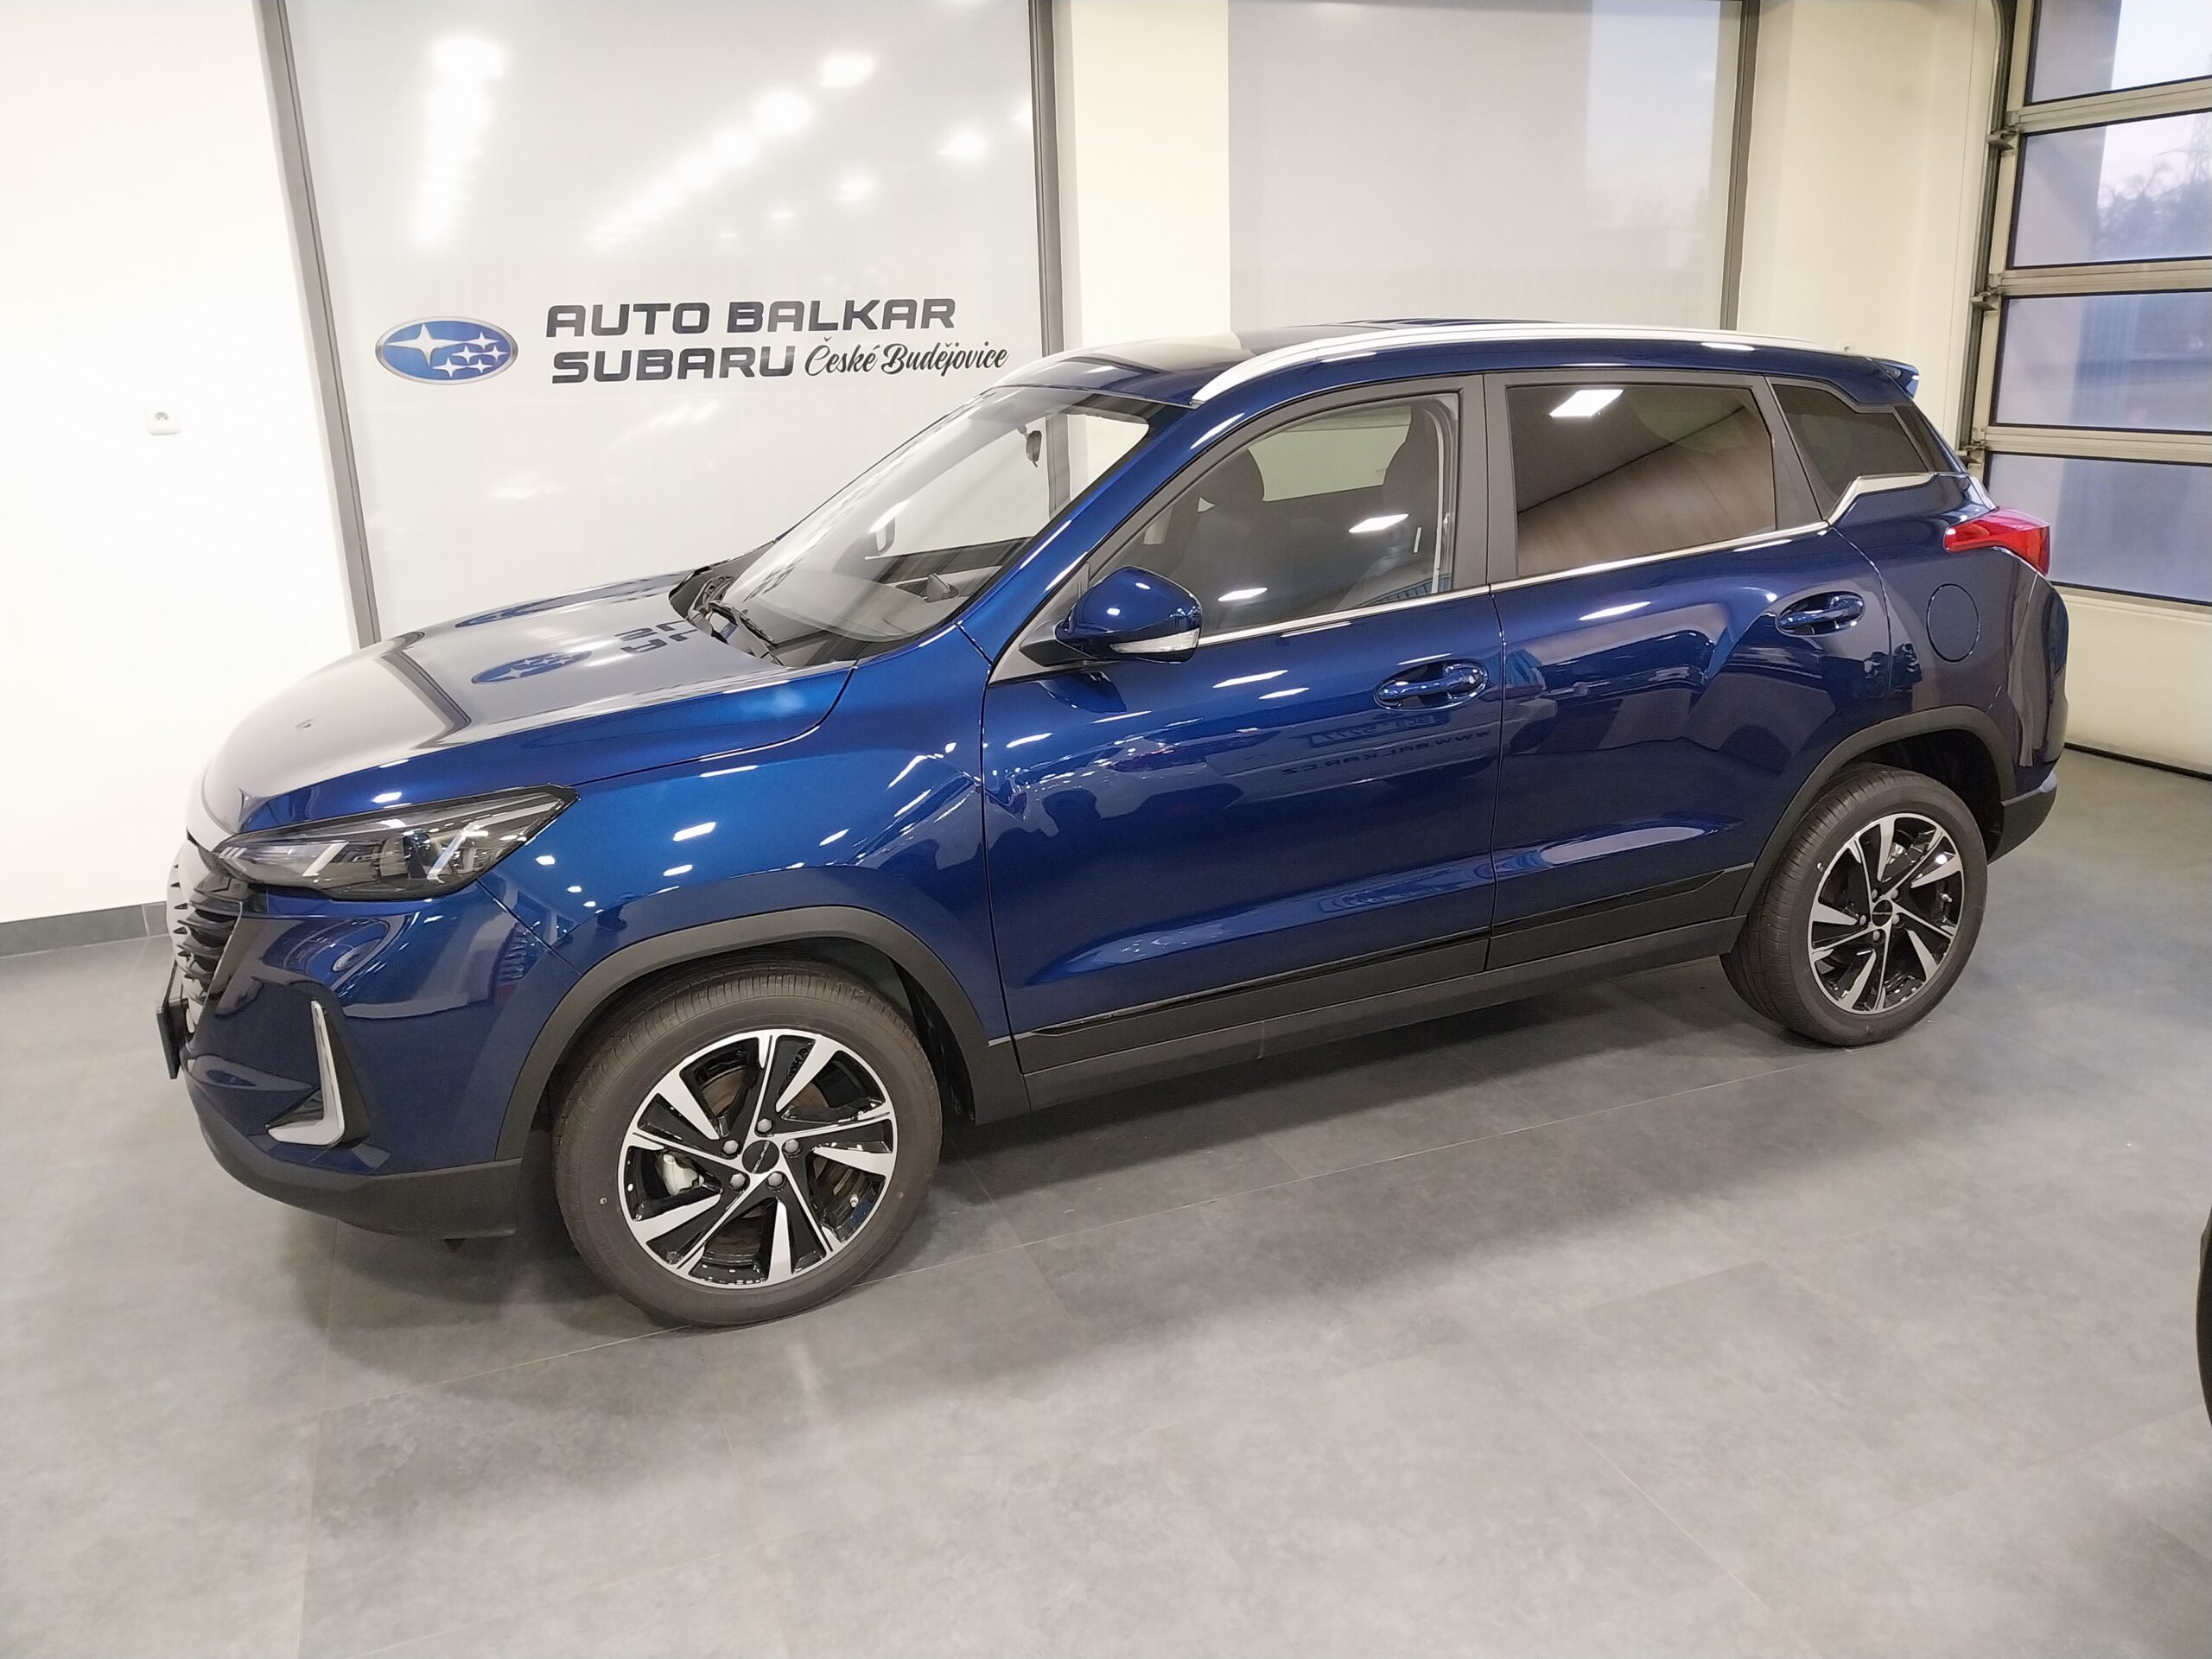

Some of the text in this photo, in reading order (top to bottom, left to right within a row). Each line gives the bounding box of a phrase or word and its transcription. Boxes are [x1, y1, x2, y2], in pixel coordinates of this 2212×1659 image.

[546, 298, 956, 338] AUTO BALKAR
[552, 336, 1009, 384] SUBARU České Budějovice
